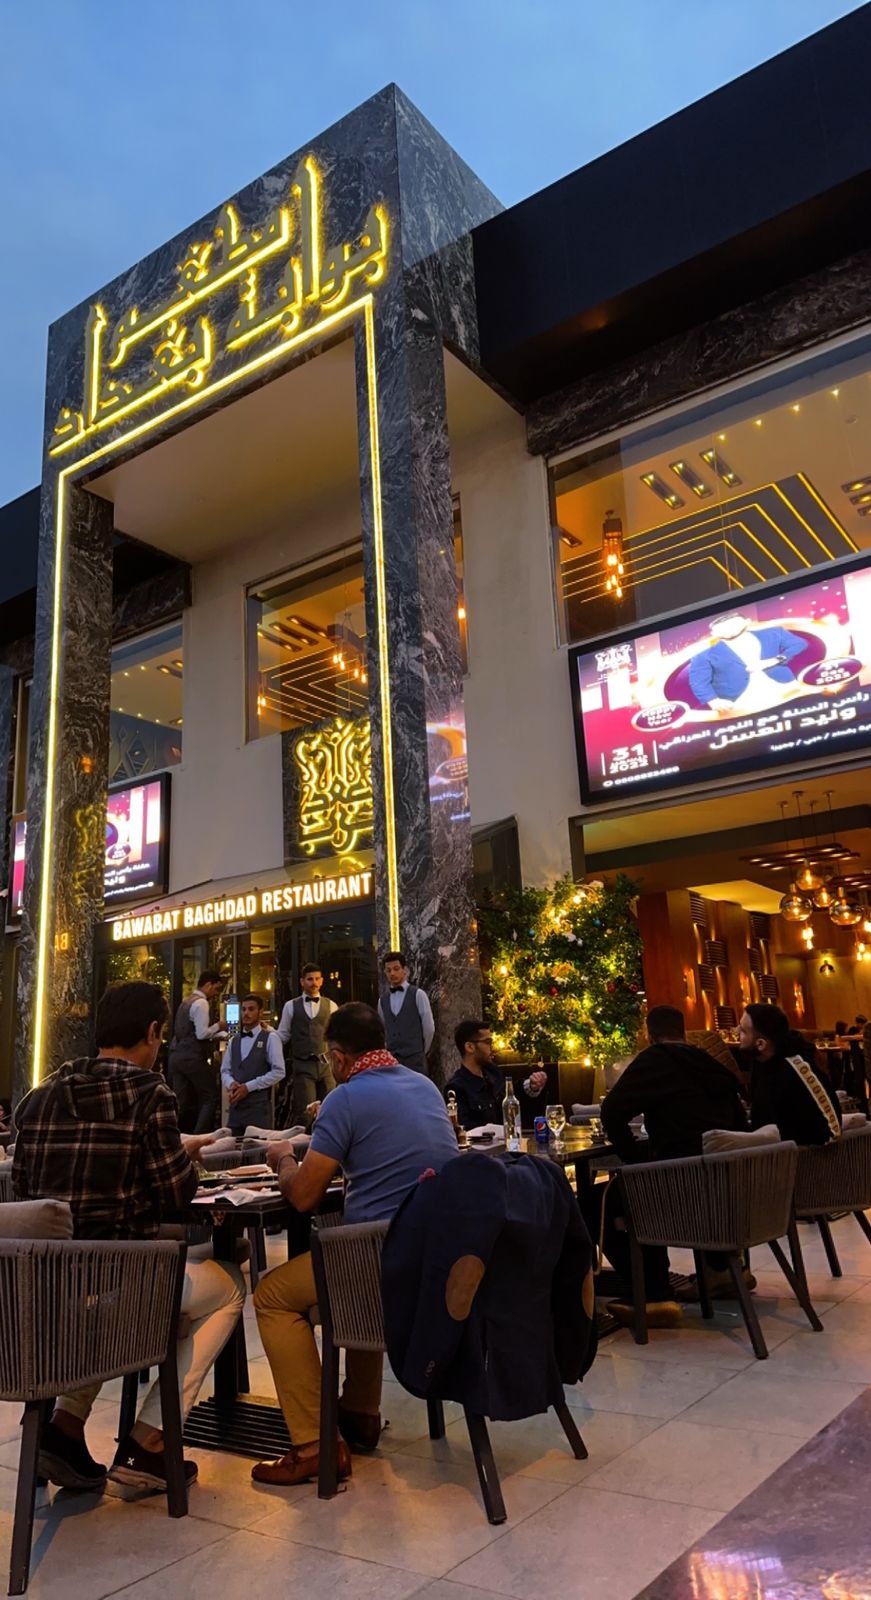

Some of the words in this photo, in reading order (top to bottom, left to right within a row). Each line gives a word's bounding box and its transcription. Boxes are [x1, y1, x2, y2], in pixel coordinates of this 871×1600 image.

[800, 707, 857, 729] وليد
[612, 743, 644, 761] 31
[112, 909, 182, 941] BAWABAT
[183, 894, 257, 928] BAGHDAD
[261, 872, 372, 914] RESTAURANT
